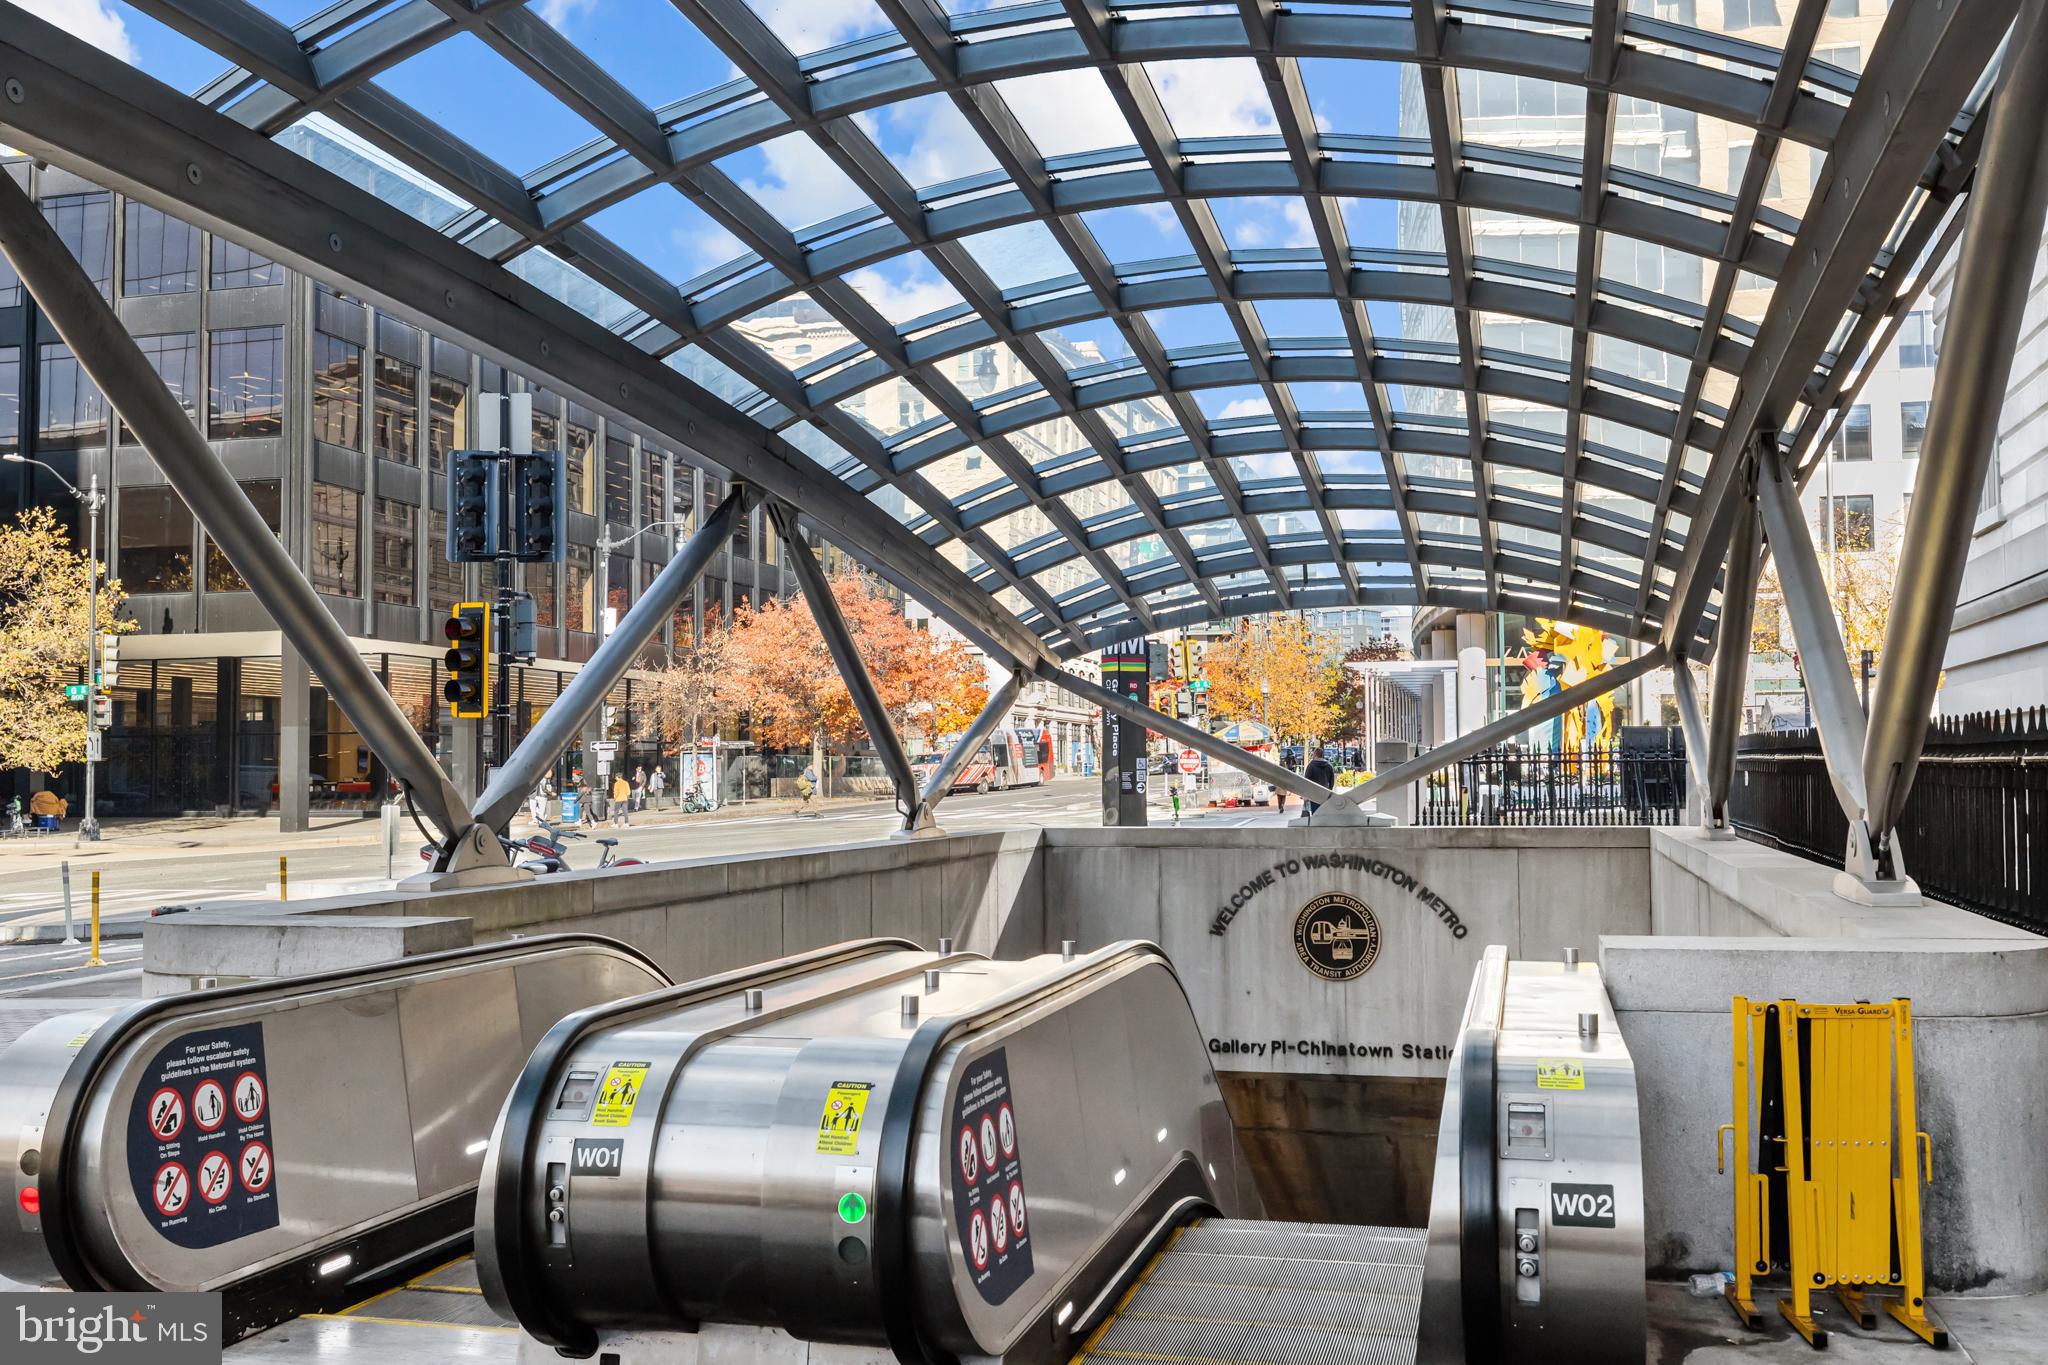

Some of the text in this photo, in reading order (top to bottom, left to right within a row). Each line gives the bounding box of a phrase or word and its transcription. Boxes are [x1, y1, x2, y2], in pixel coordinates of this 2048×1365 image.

[1209, 853, 1467, 940] WELCOME TO WASHINGTON METRO
[1296, 896, 1376, 938] WASHINGTON METROPOLITAN
[1296, 942, 1377, 978] AREA TRANSIT AUTHORITY
[166, 1048, 250, 1070] please follow escalator safety
[185, 1046, 196, 1054] For
[197, 1045, 210, 1054] your
[1208, 1038, 1267, 1057] Gallery
[1271, 1040, 1393, 1058] Pl-Chinatown
[160, 1070, 192, 1082] guidelines
[210, 1060, 236, 1071] Metrorail
[236, 1057, 256, 1067] system
[577, 1147, 620, 1167] W01
[1553, 1193, 1613, 1218] W02
